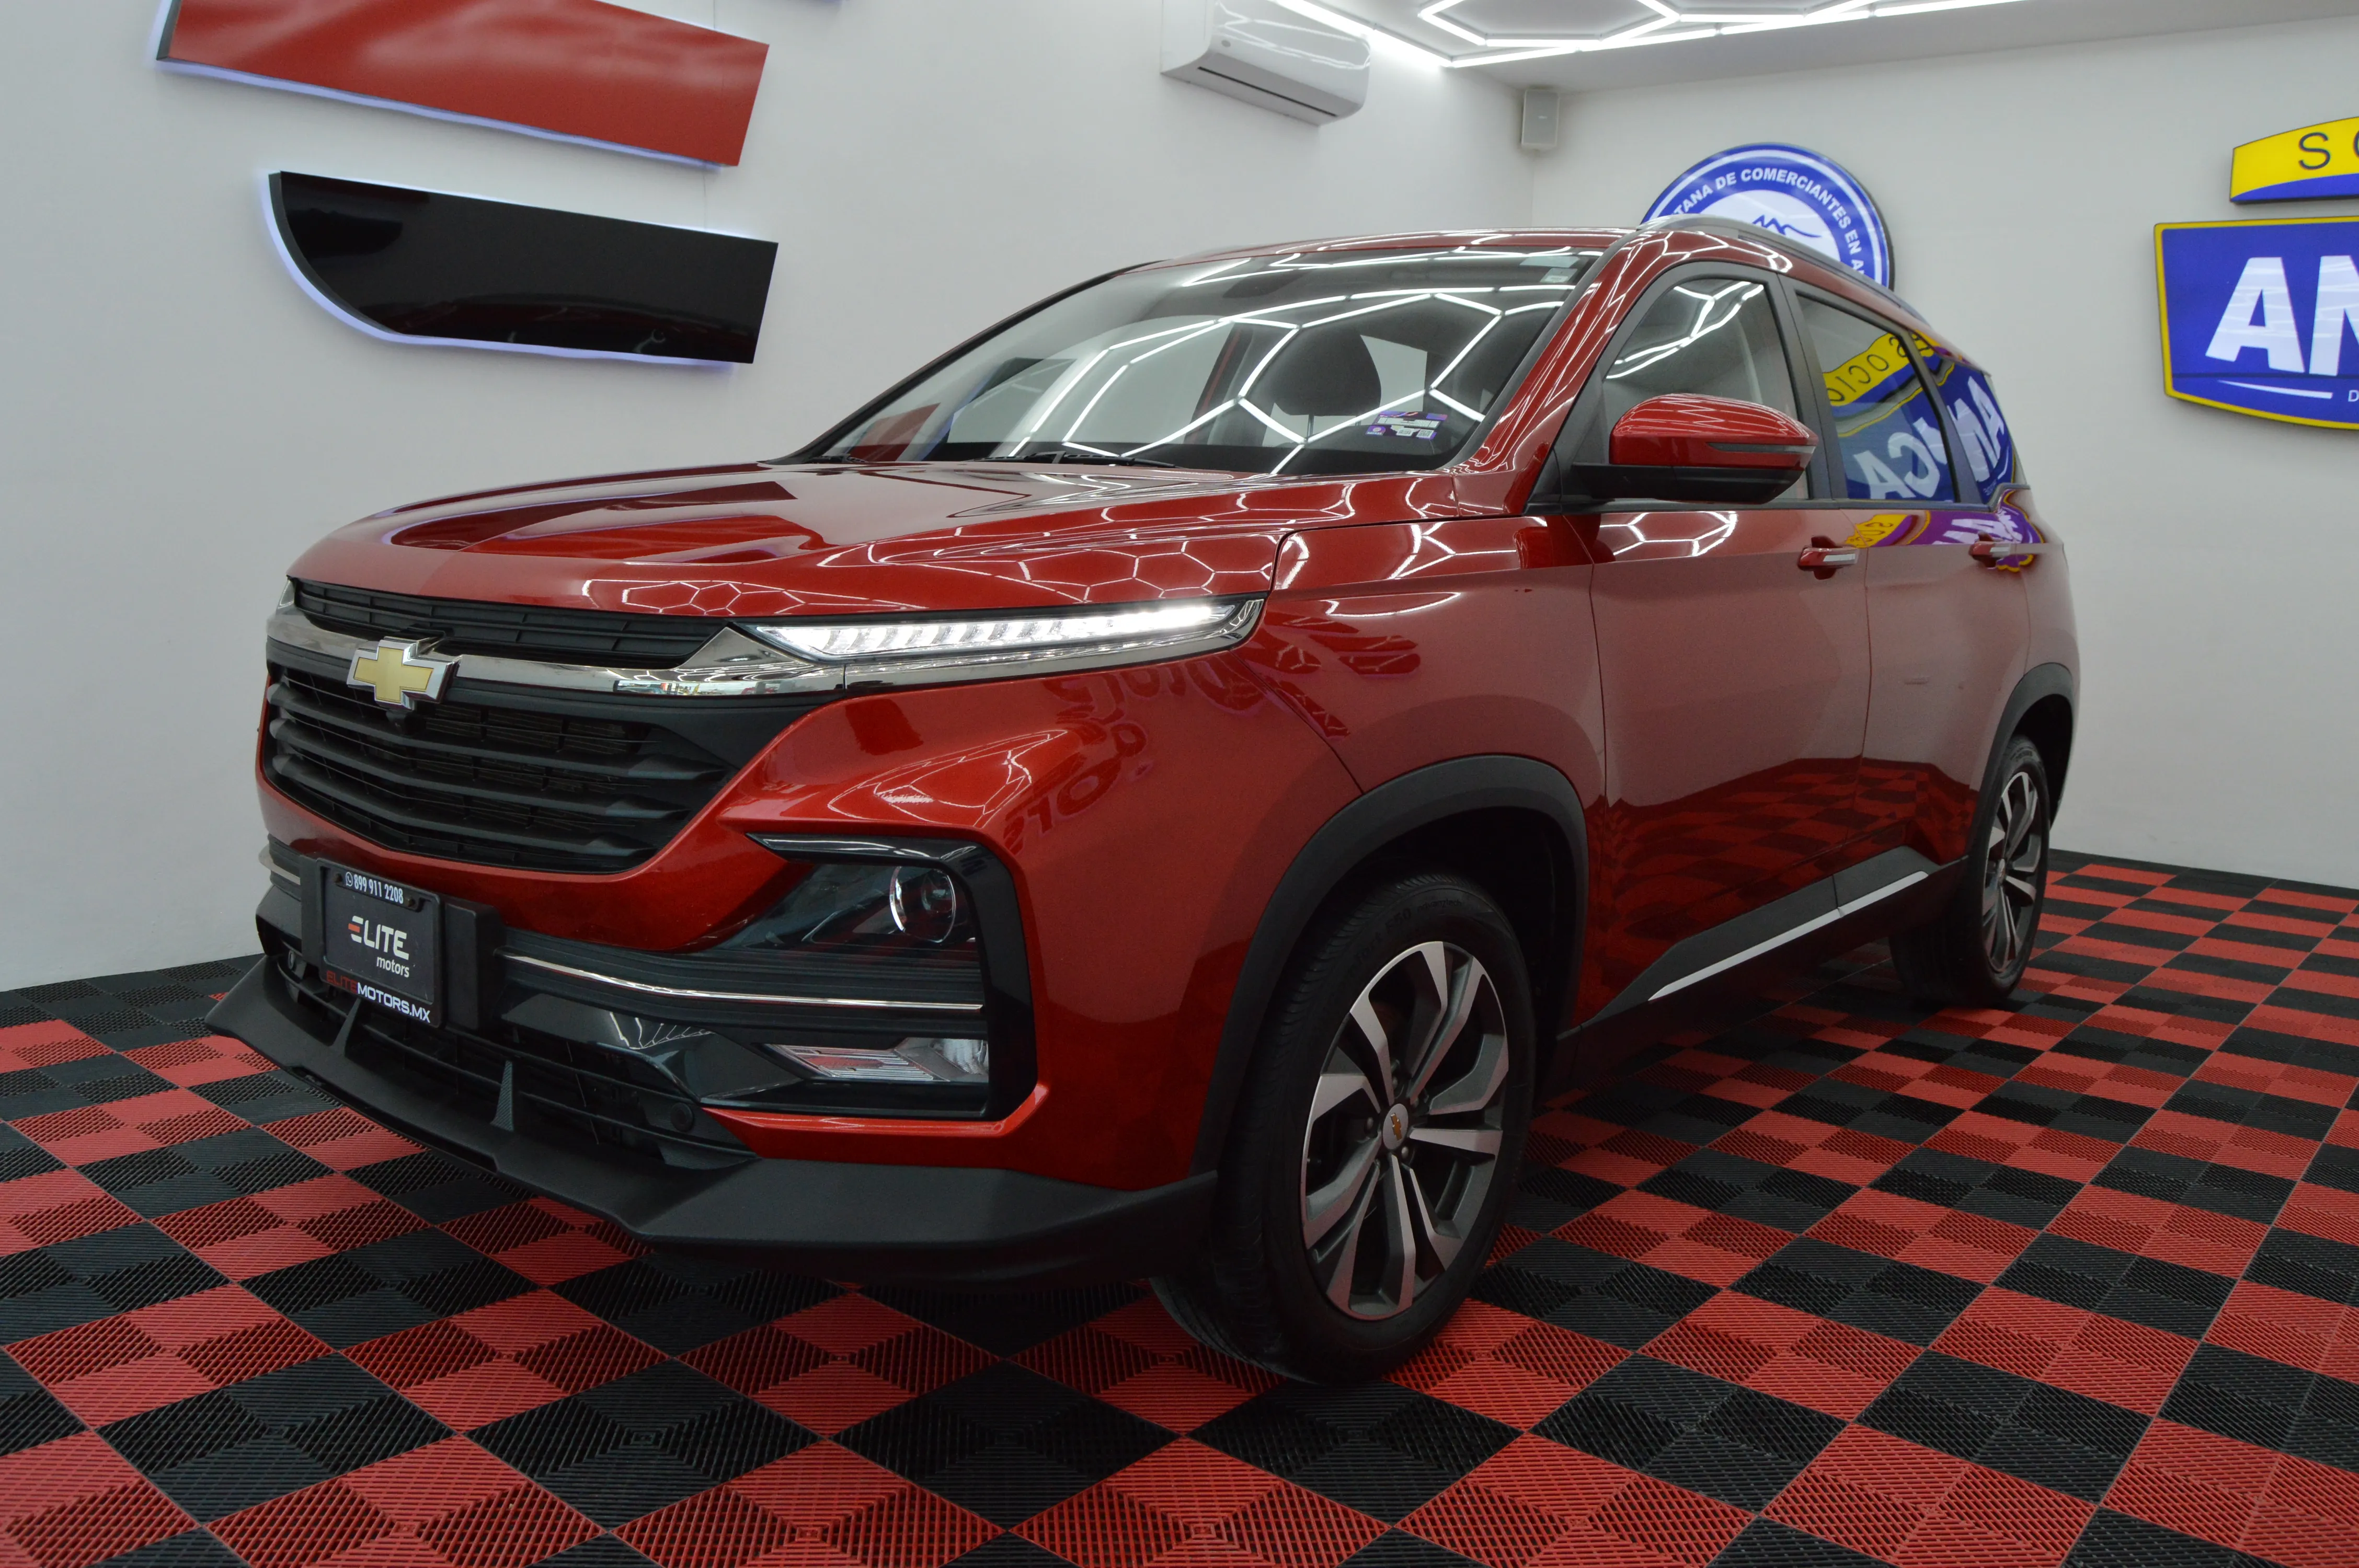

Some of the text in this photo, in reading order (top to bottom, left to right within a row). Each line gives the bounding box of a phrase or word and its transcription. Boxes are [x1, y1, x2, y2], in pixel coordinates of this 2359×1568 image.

[2298, 131, 2359, 170] S
[1715, 172, 1736, 190] DE
[1740, 168, 1851, 229] COMERCIANTES
[1845, 229, 1862, 255] EN
[1851, 259, 1864, 274] A
[354, 874, 404, 904] 899 911 2208
[348, 915, 409, 960] ELITE
[376, 955, 410, 978] motors
